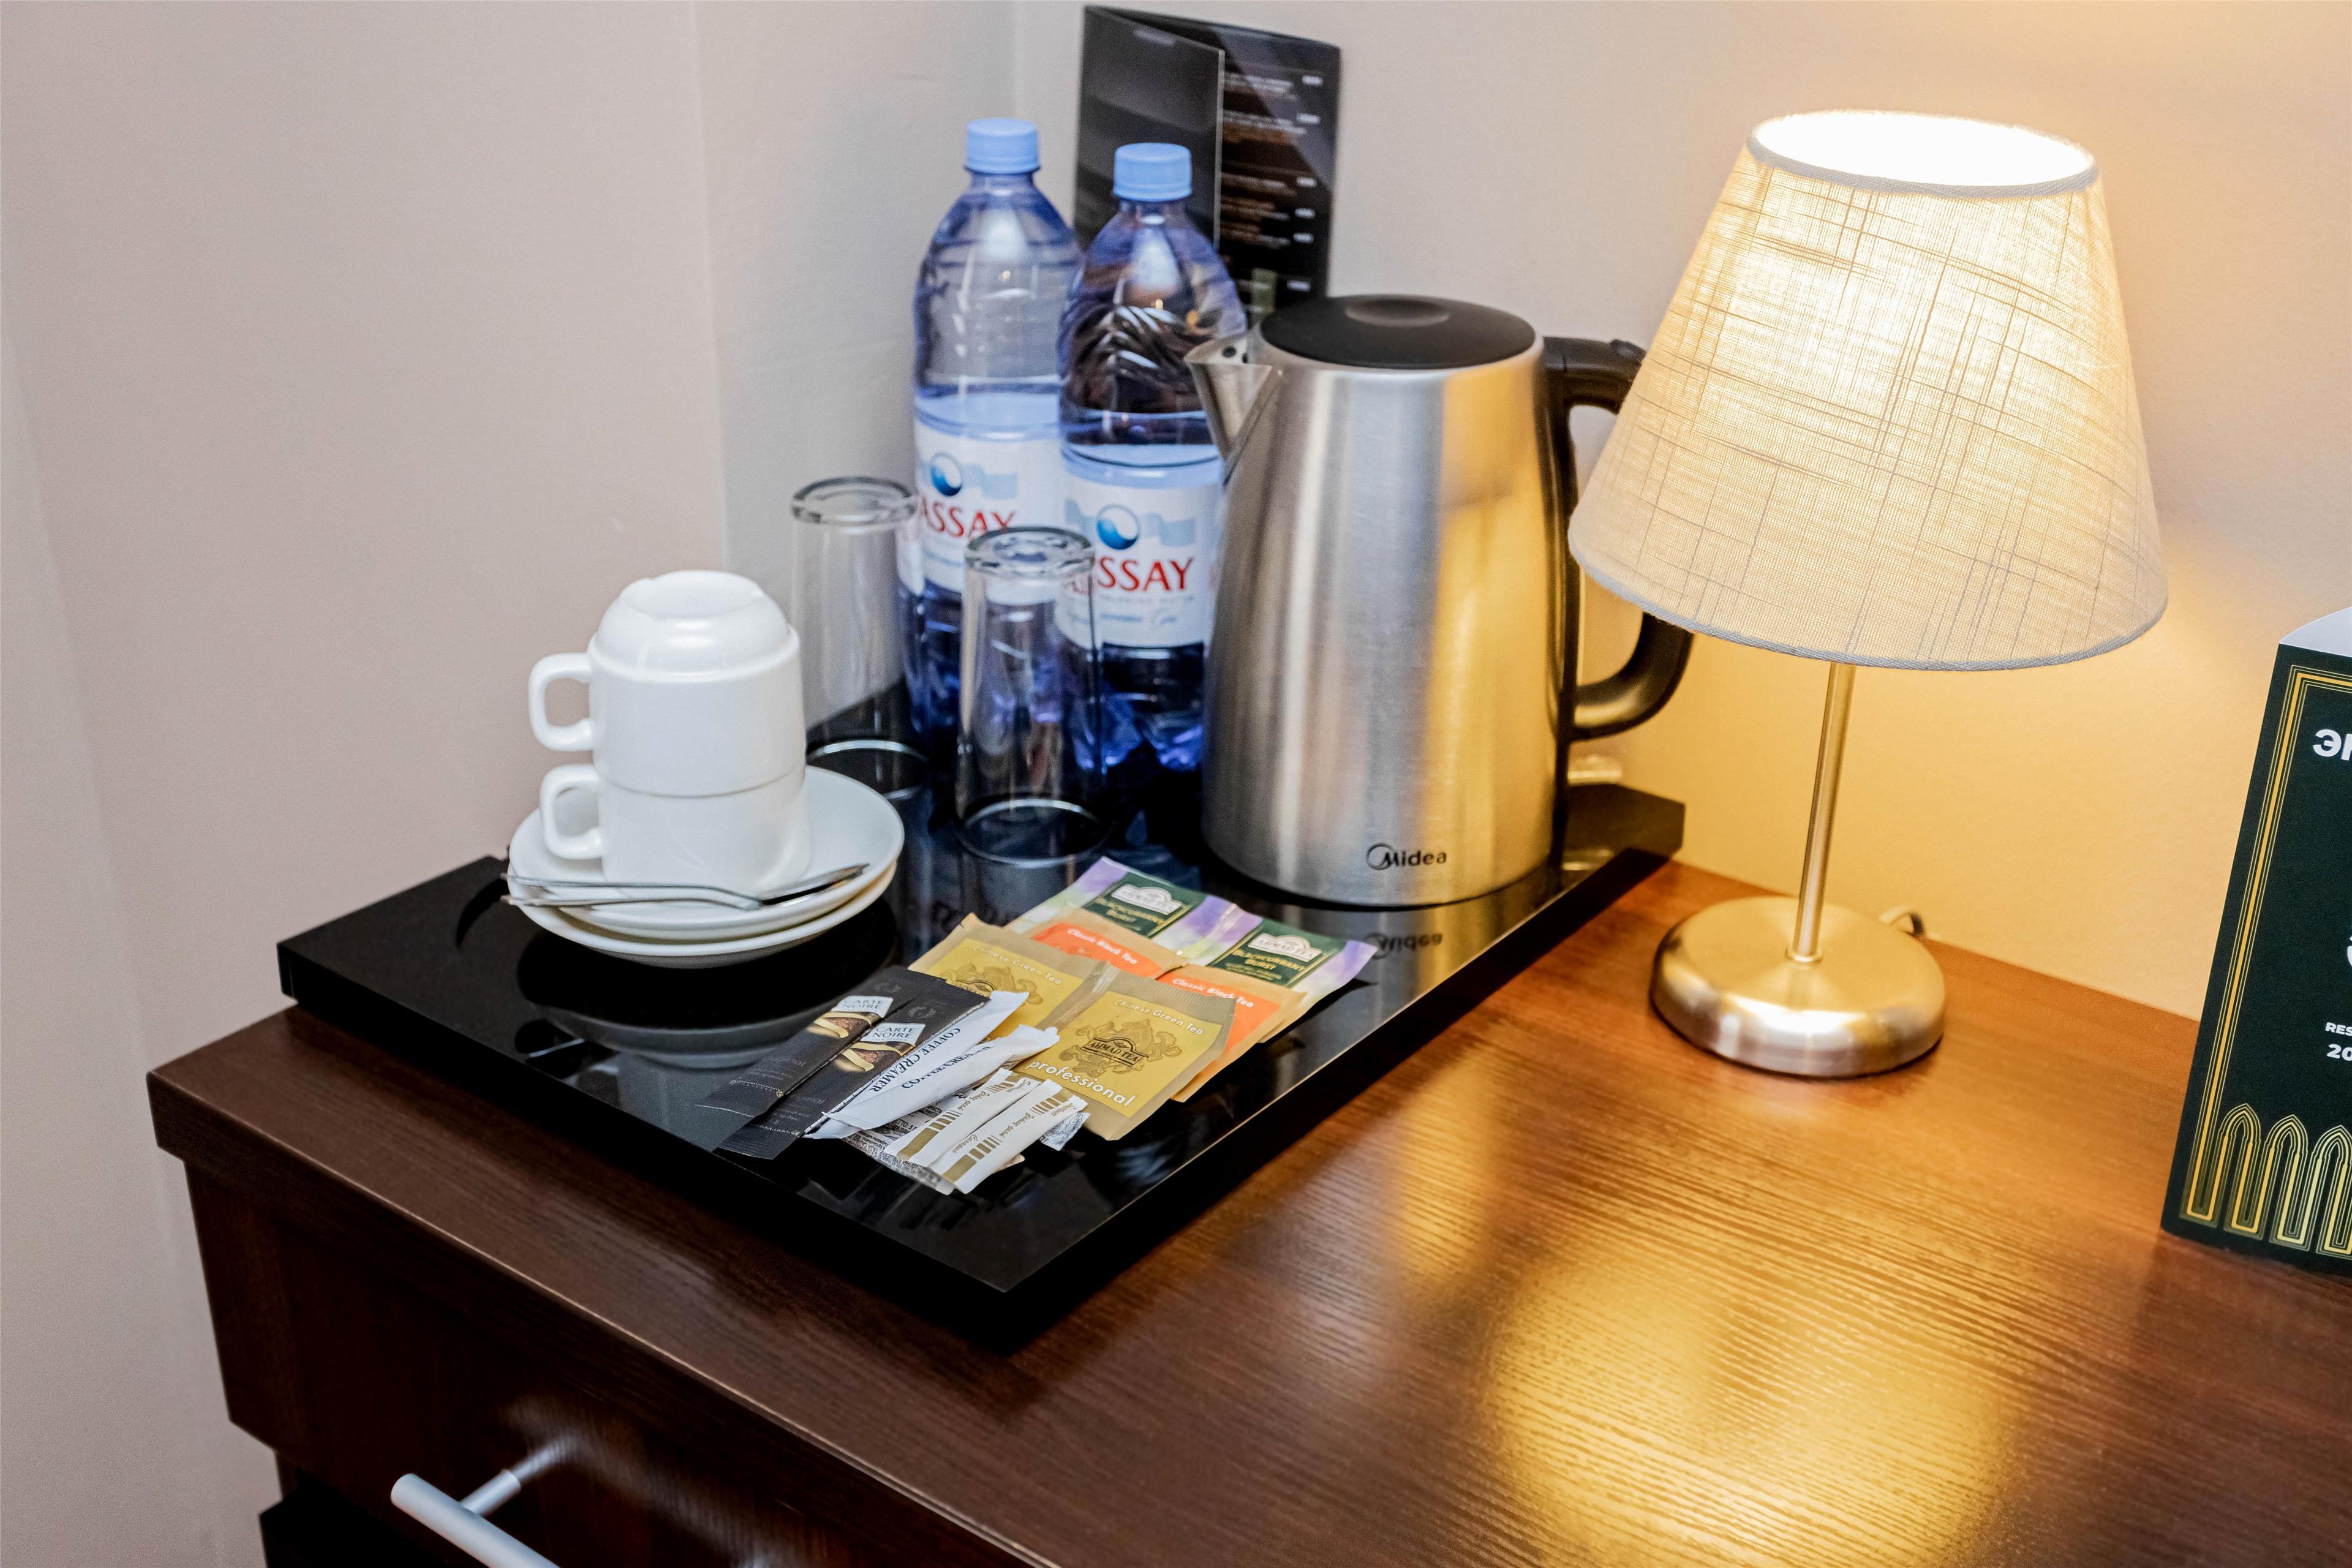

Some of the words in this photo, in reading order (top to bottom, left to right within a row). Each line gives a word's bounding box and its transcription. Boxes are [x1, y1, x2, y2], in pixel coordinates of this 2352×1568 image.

[1073, 556, 1194, 594] SSAY
[1366, 843, 1447, 870] Midea
[1012, 960, 1042, 976] Green
[1045, 972, 1062, 985] Tea
[1172, 979, 1205, 992] Classic
[1207, 987, 1235, 999] Black
[1236, 996, 1254, 1008] Tea
[1114, 999, 1150, 1014] Chinese
[1153, 1009, 1184, 1026] Green
[1185, 1022, 1204, 1036] Tea
[922, 1028, 960, 1056] COFFEE
[1088, 1041, 1122, 1055] AHMAD
[1121, 1050, 1141, 1063] TEA
[869, 1054, 921, 1093] CREAMER
[1024, 1061, 1136, 1107] professional
